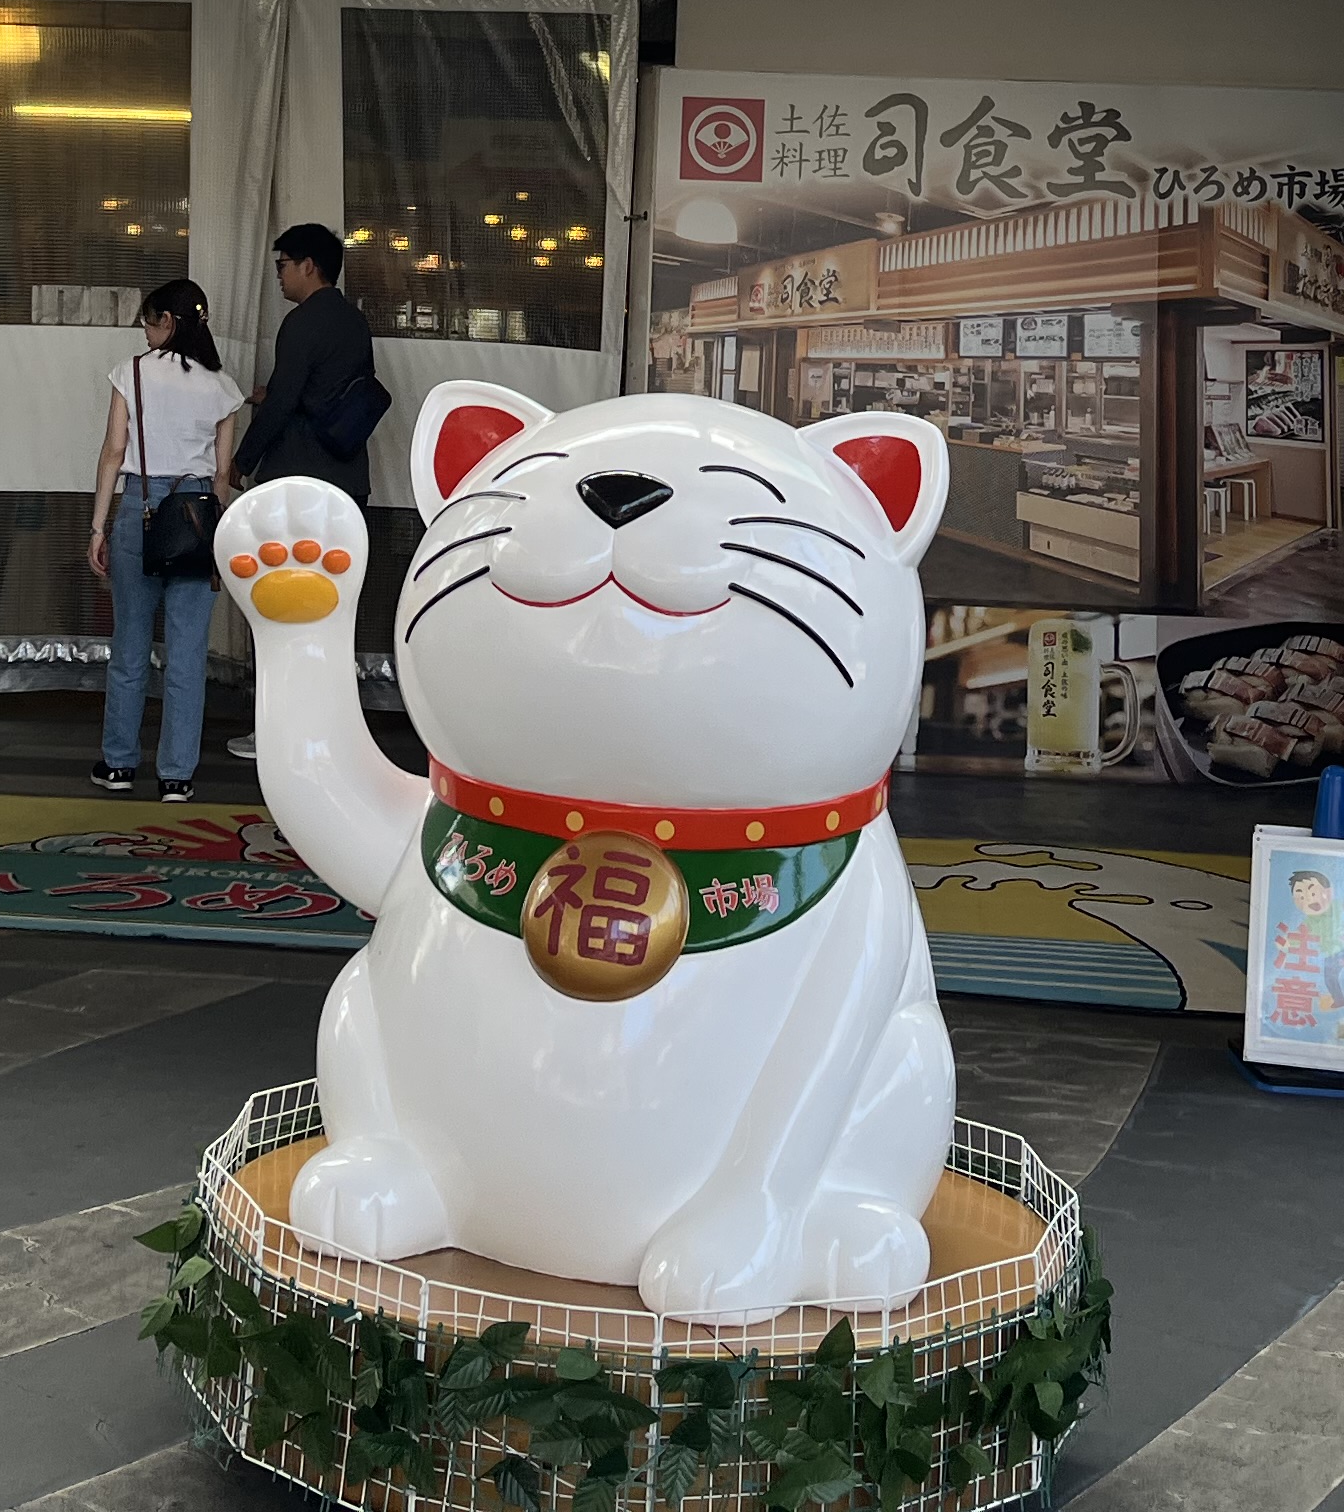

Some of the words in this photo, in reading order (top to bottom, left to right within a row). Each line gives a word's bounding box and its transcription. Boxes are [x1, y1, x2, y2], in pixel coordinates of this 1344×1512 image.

[776, 102, 852, 140] 土佐
[862, 93, 1138, 201] 司食堂
[771, 142, 851, 180] 料理
[438, 833, 518, 897] ひろめ
[699, 874, 780, 919] 市場
[534, 846, 652, 967] 福
[1271, 922, 1321, 1028] 注意
